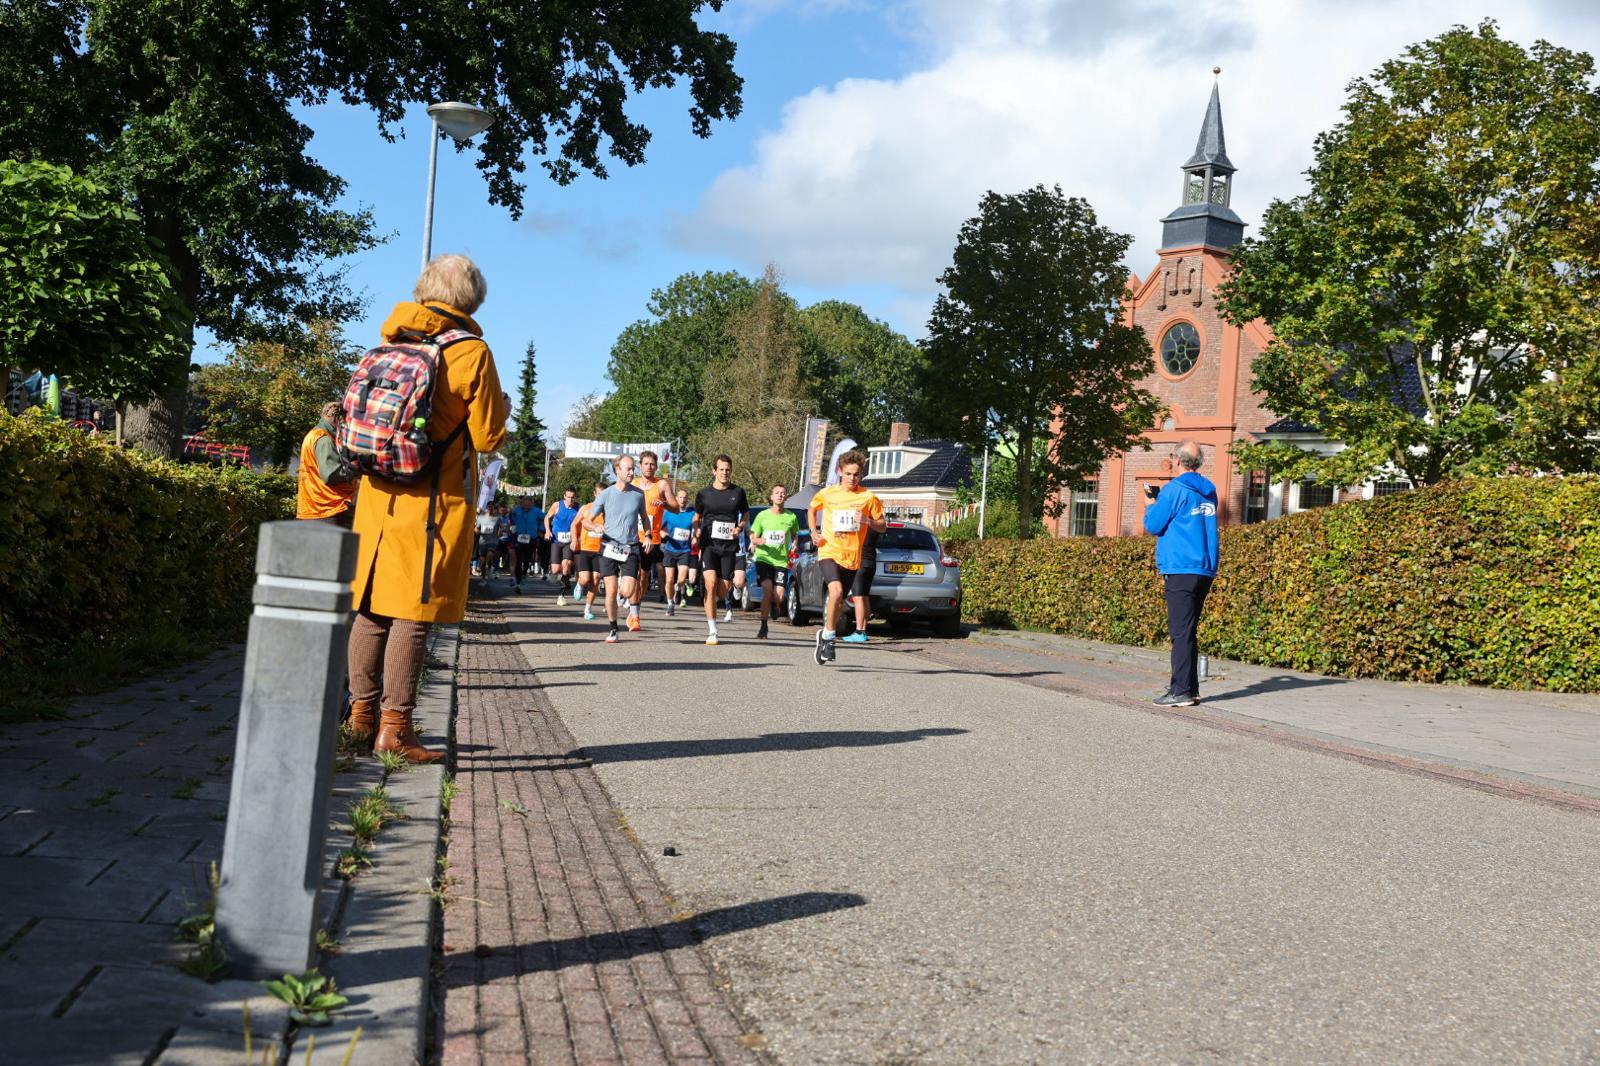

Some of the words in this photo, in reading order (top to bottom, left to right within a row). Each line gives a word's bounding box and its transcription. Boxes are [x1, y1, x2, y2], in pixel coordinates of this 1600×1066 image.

[579, 441, 612, 453] START
[623, 443, 658, 455] FINISH
[839, 516, 854, 525] 411
[717, 526, 730, 535] 490
